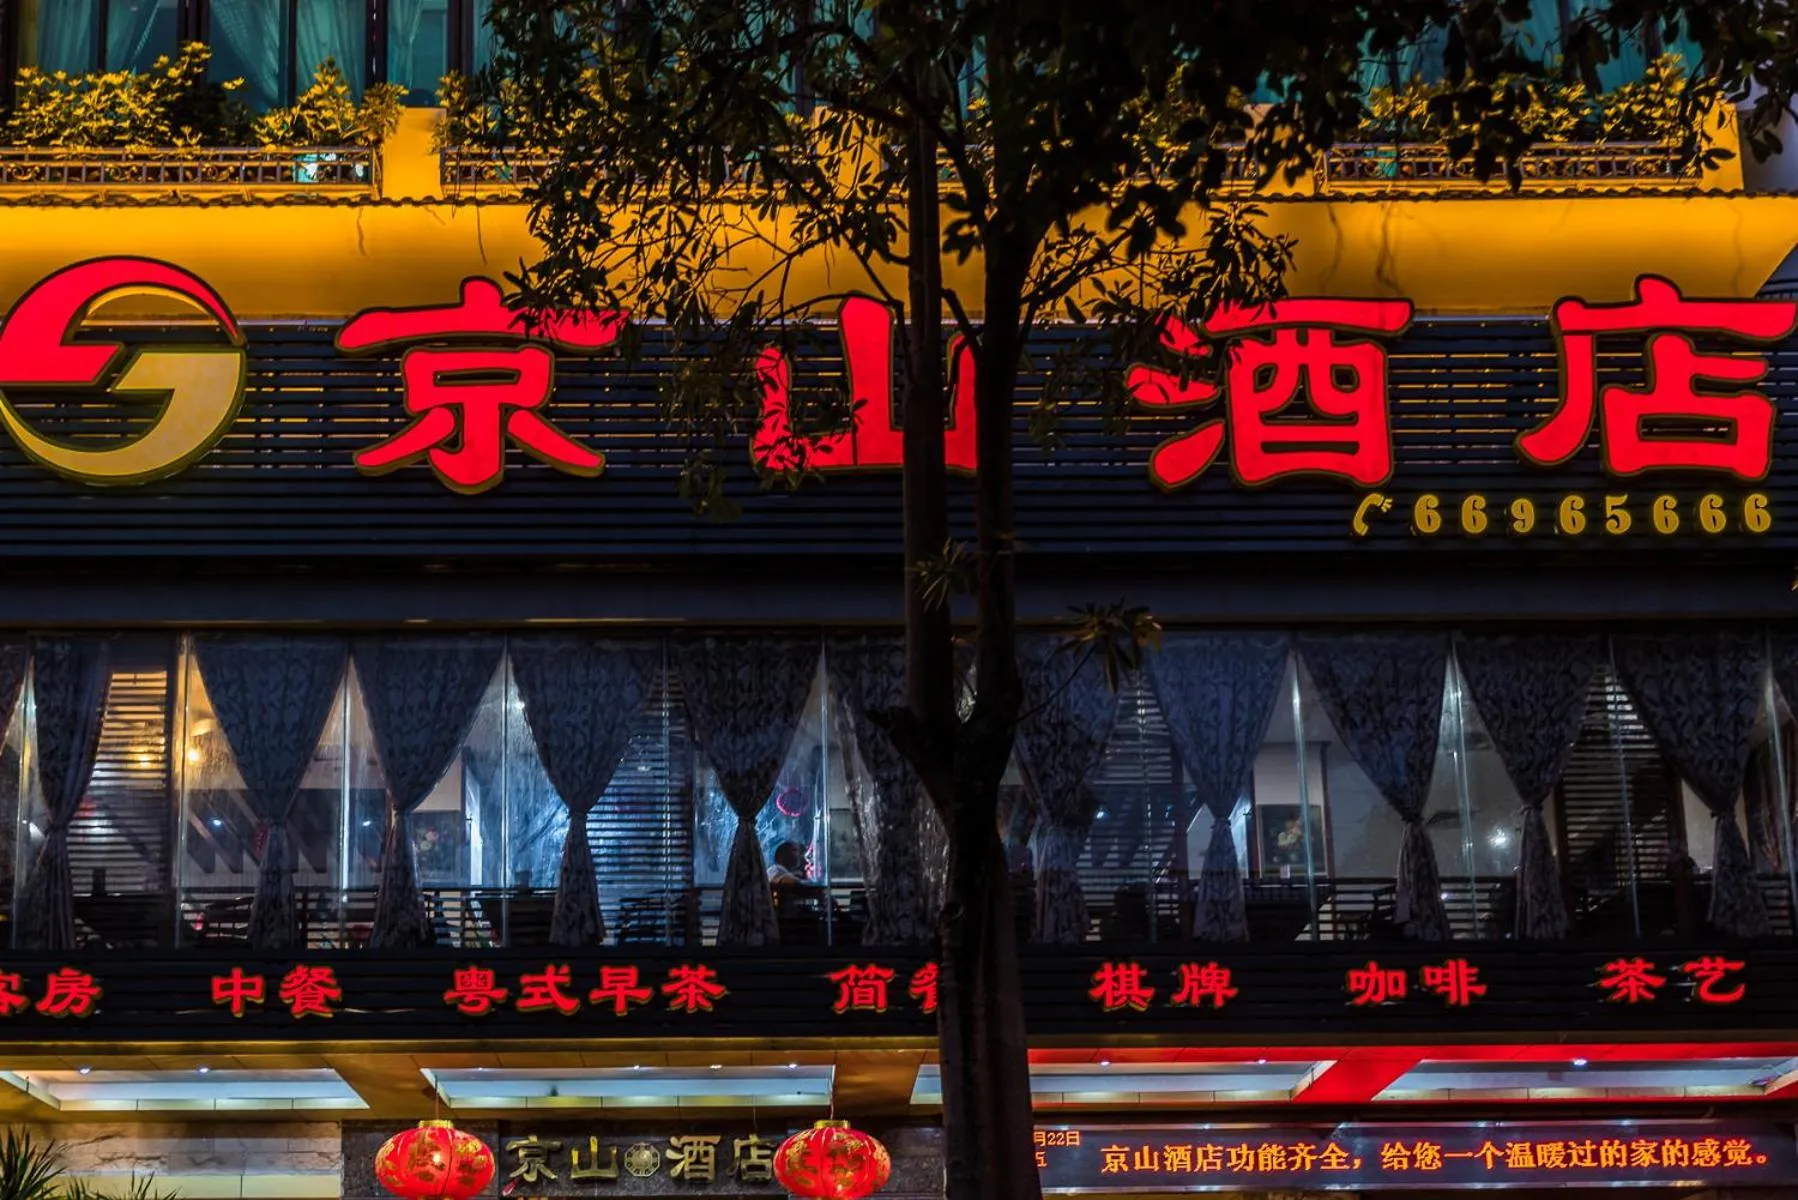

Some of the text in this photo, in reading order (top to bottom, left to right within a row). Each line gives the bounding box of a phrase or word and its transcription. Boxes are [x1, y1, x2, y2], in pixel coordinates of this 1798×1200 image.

[336, 277, 1798, 495] 京山酒店
[1413, 493, 1772, 535] 66965666
[211, 964, 342, 1017] 中餐
[444, 964, 727, 1015] 粤式早茶
[1089, 962, 1238, 1011] 棋牌
[1348, 959, 1487, 1006] 咖啡
[1600, 957, 1746, 1003] 茶艺
